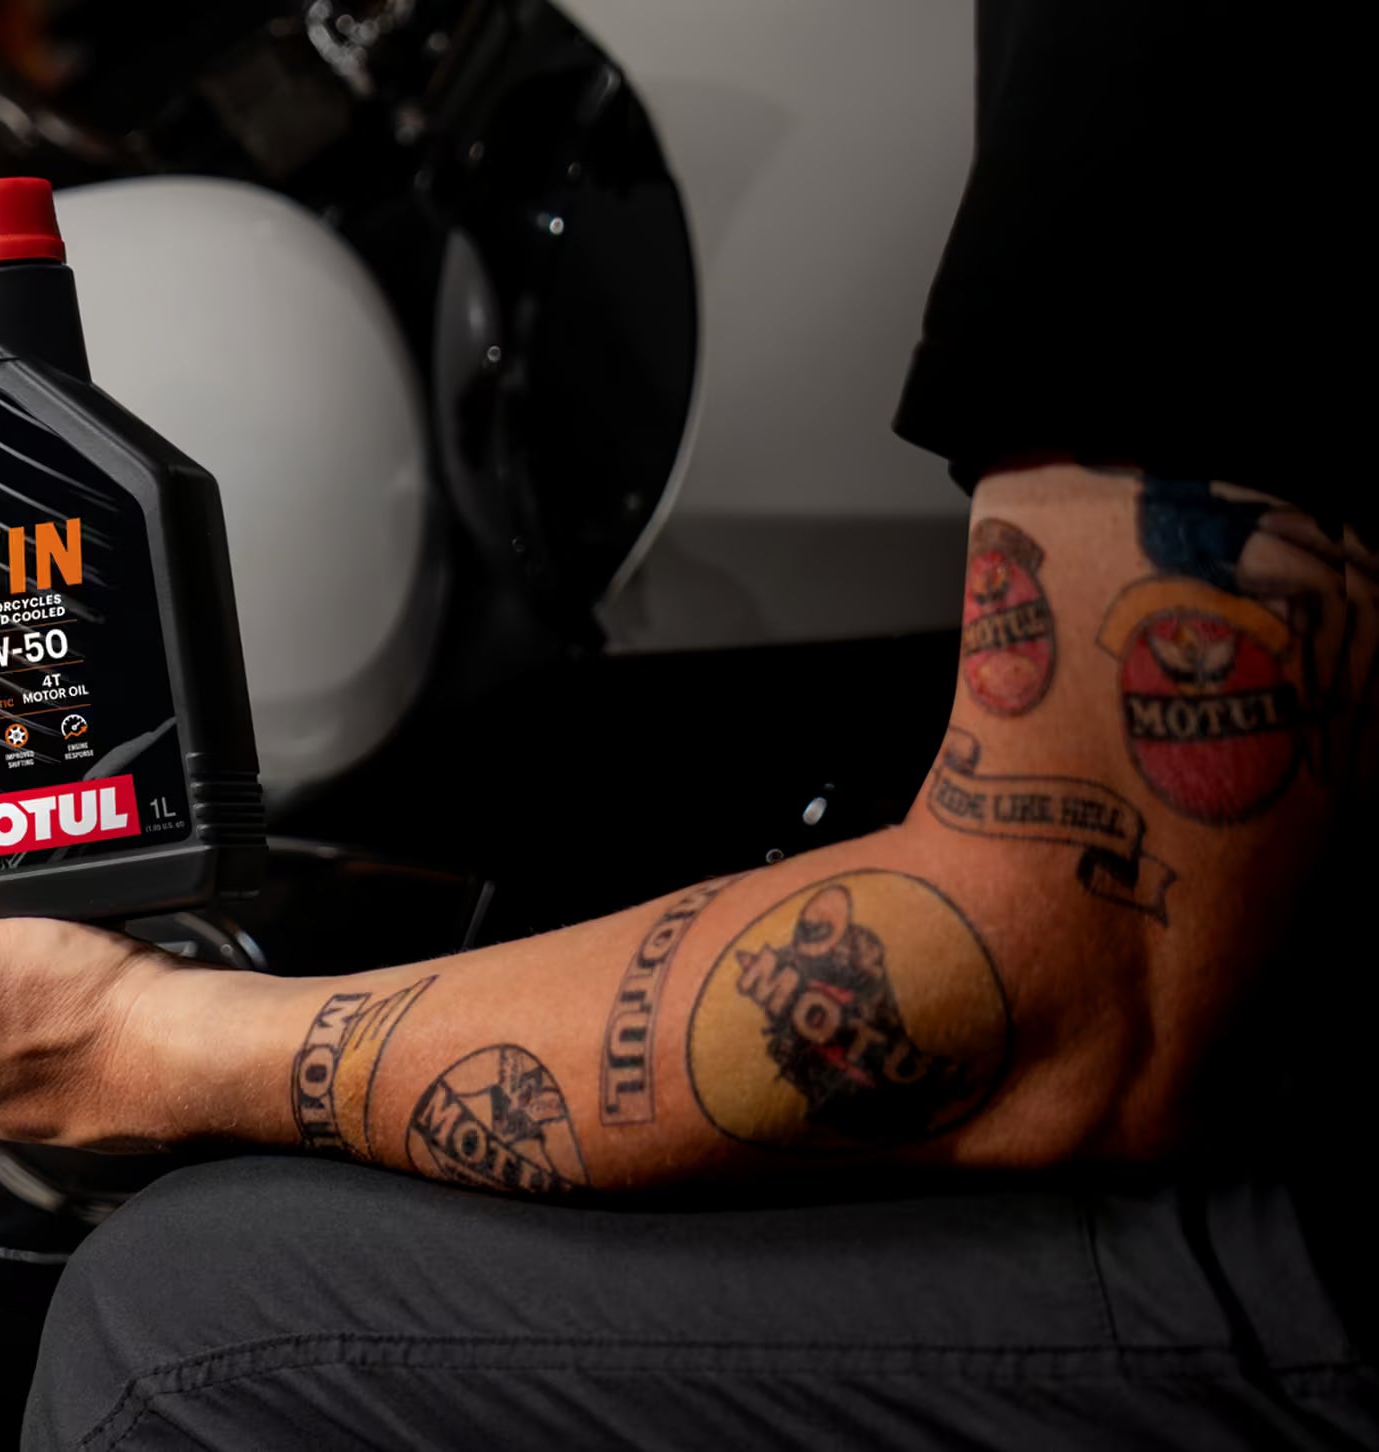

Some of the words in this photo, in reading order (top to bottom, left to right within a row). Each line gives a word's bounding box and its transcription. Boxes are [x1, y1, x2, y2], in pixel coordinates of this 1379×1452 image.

[12, 606, 66, 623] COOLED
[42, 673, 61, 688] 4T
[22, 688, 66, 704] MOTOR
[69, 685, 89, 697] OIL
[5, 750, 34, 761] IMPROVED
[64, 750, 94, 760] RESPONSE
[67, 742, 88, 751] ENGINE
[8, 759, 34, 769] SHIFTING
[149, 796, 176, 819] 1L
[994, 794, 1054, 825] LIKE
[1060, 796, 1126, 838] HELL
[736, 943, 946, 1090] MOTU
[301, 998, 366, 1150] MOT
[417, 1080, 571, 1194] MOTU
